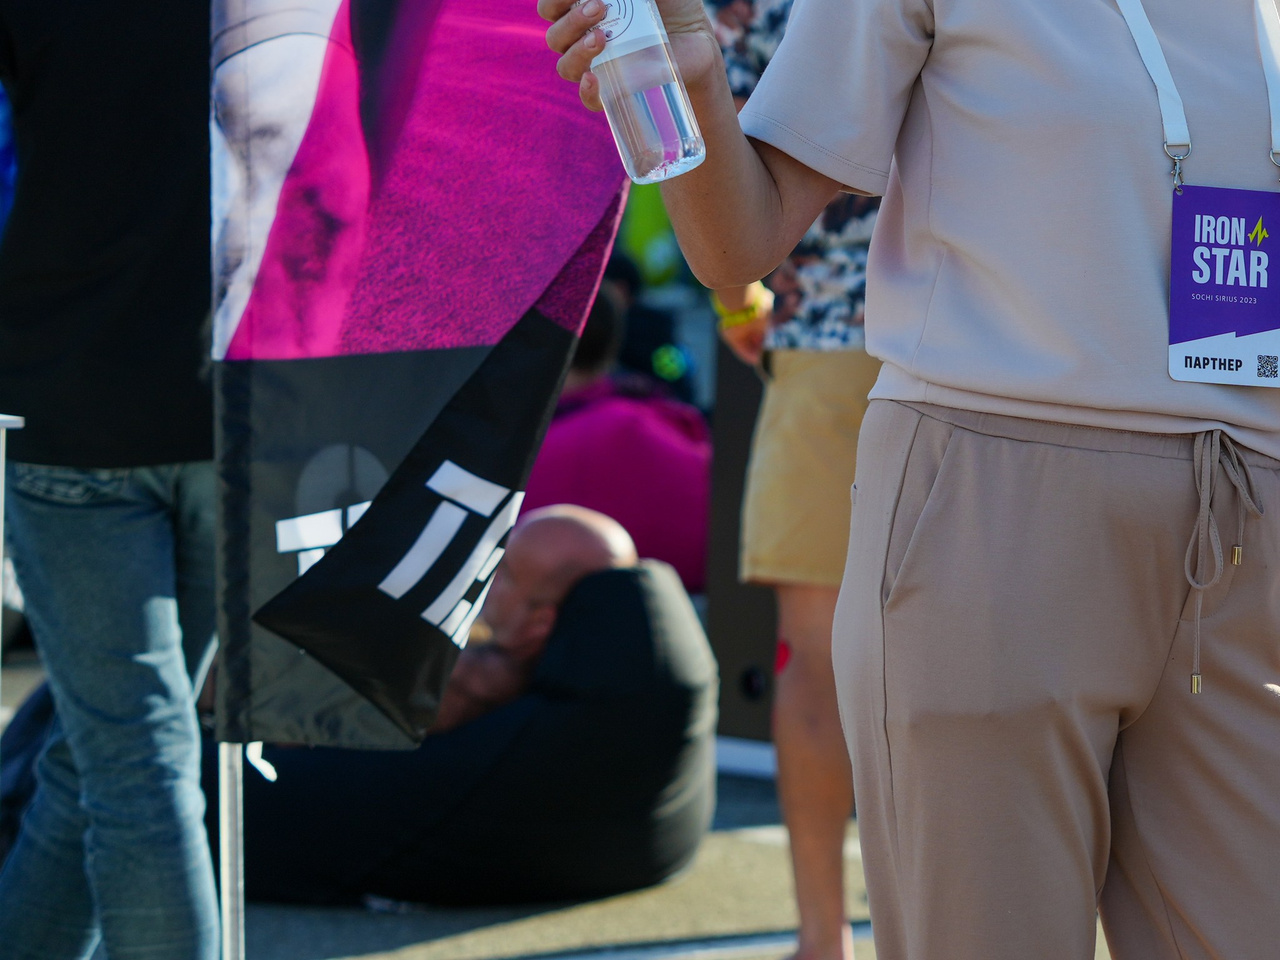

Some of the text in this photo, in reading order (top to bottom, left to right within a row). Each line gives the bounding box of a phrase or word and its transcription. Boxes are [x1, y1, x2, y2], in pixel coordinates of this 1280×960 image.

[1194, 214, 1246, 246] IRON
[1191, 245, 1269, 289] STAR
[1191, 293, 1257, 305] SOCHI SIRIUS 2023
[1184, 355, 1243, 372] ПАРТНЕР
